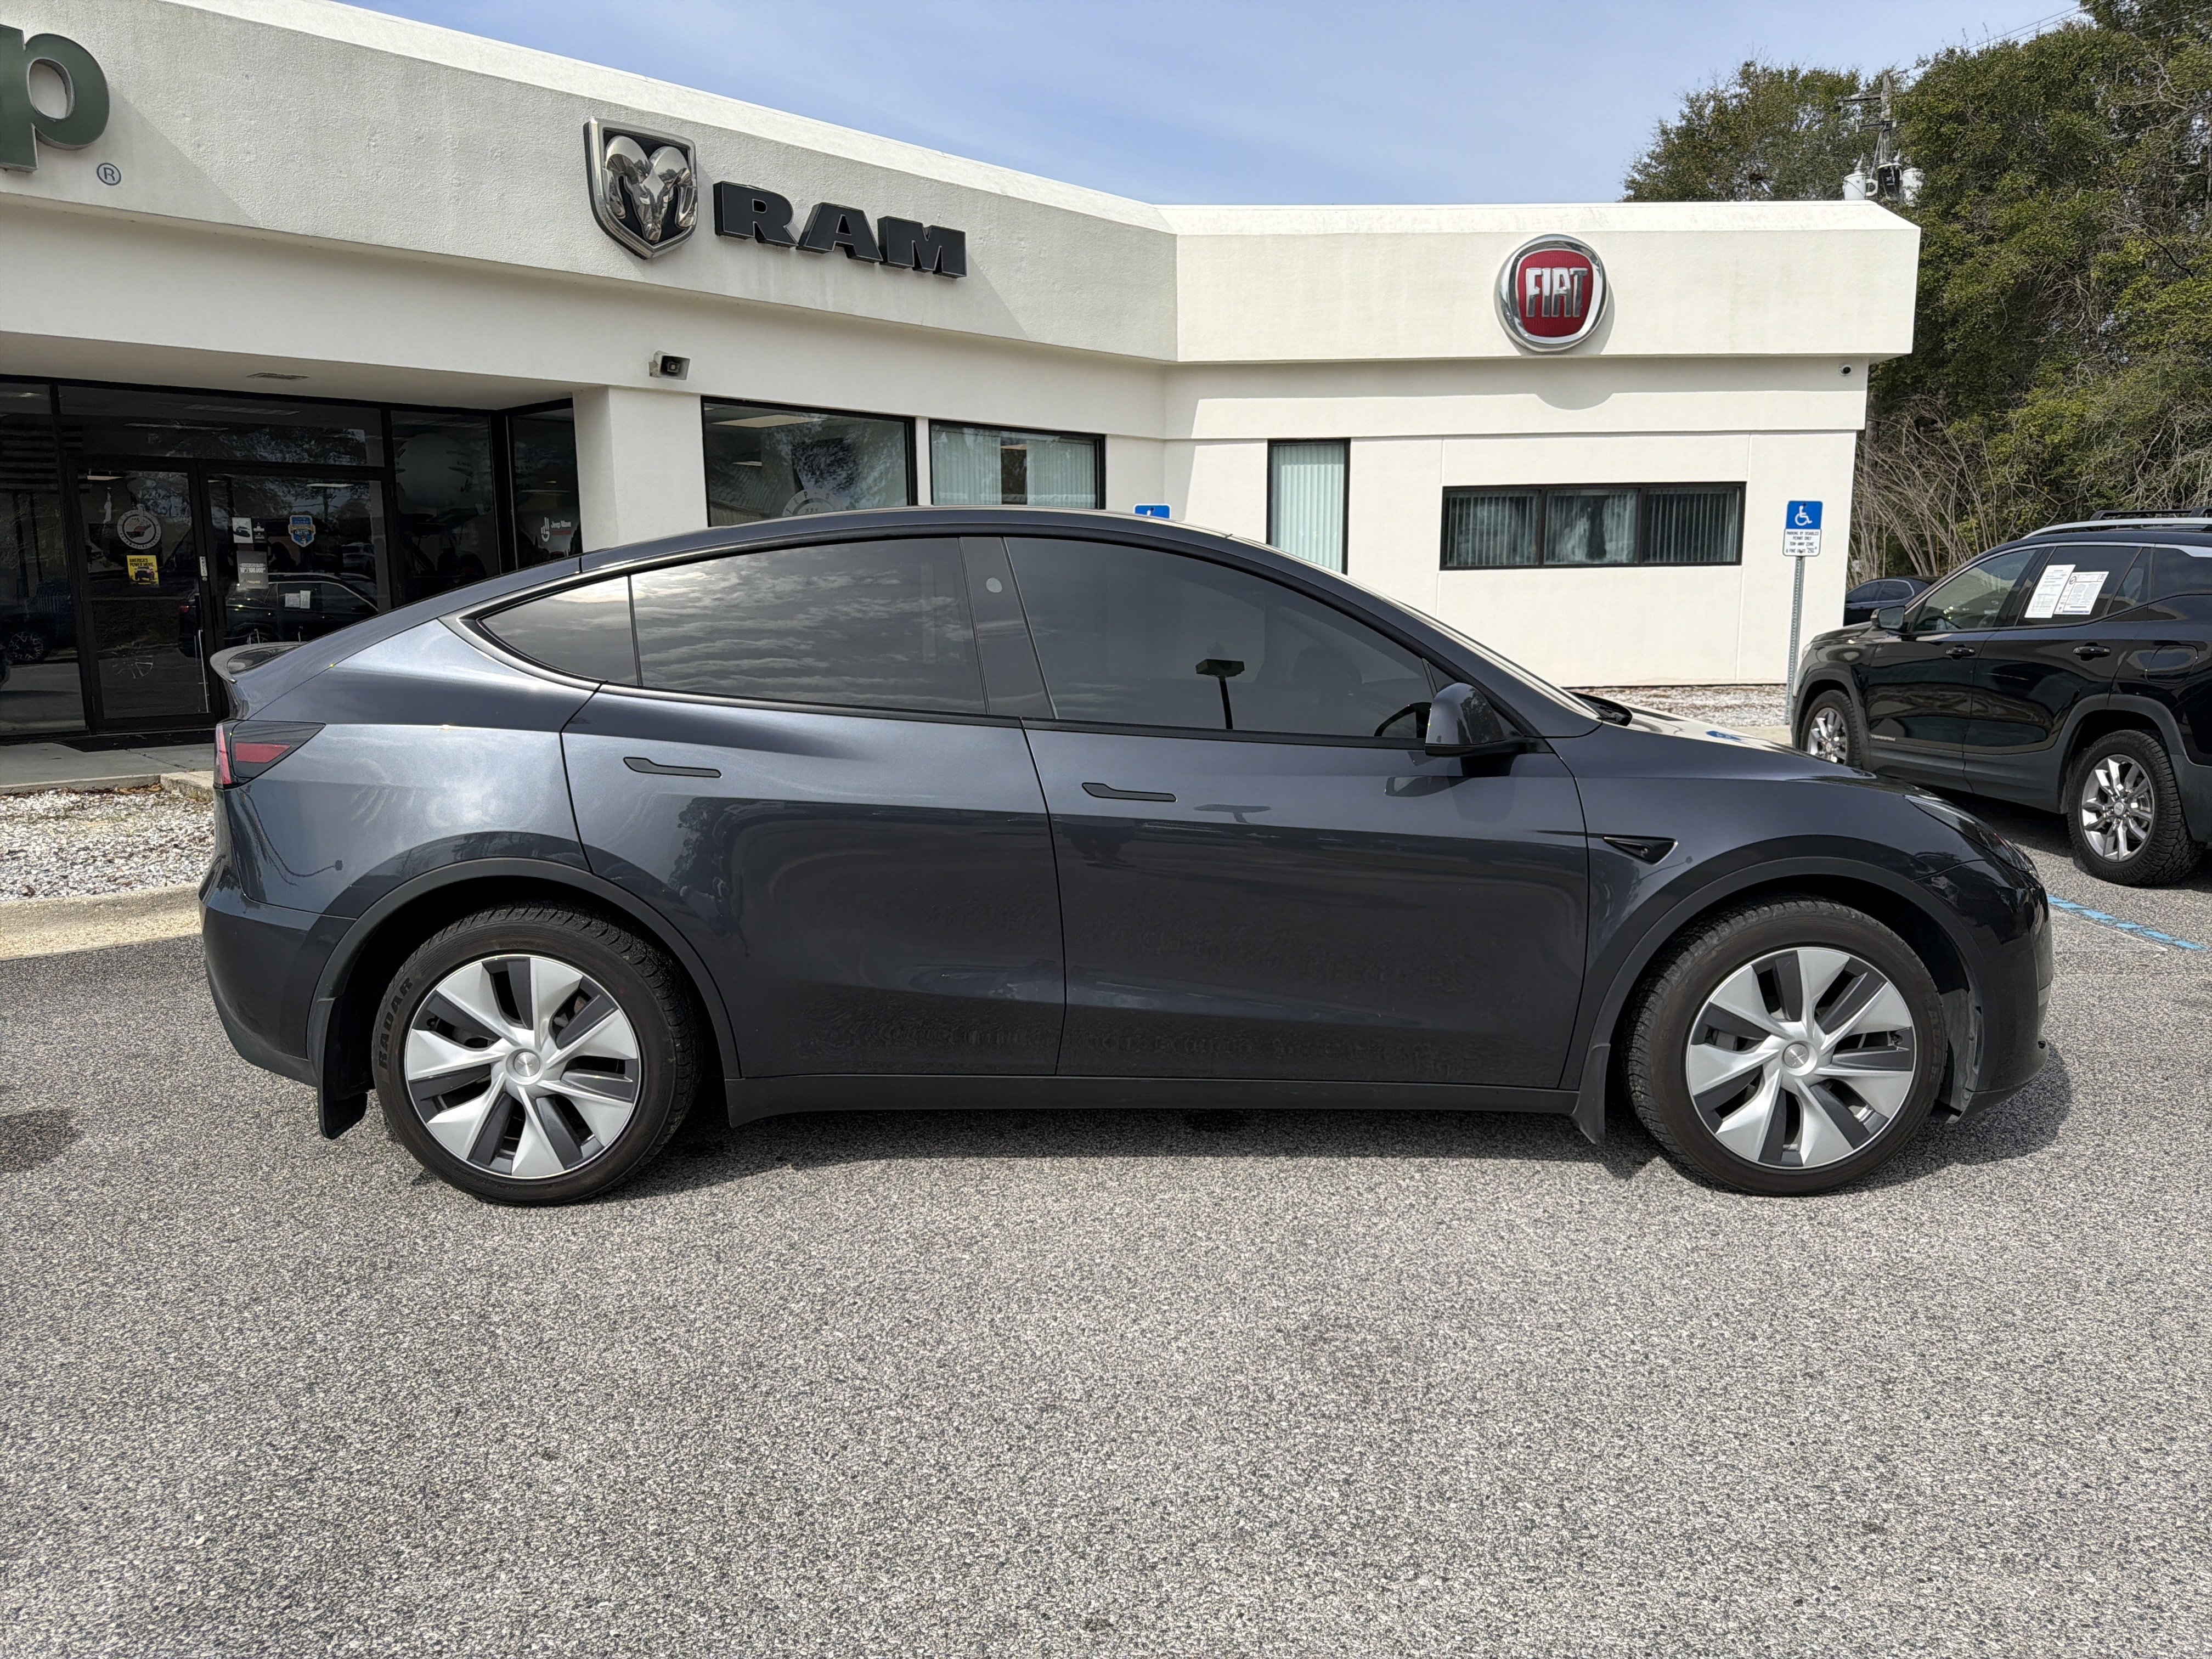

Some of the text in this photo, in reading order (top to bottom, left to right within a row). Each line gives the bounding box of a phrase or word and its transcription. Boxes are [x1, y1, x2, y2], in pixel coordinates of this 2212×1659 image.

[713, 181, 967, 279] RAM
[1525, 267, 1588, 318] FIAT
[379, 977, 413, 1070] RADAR
